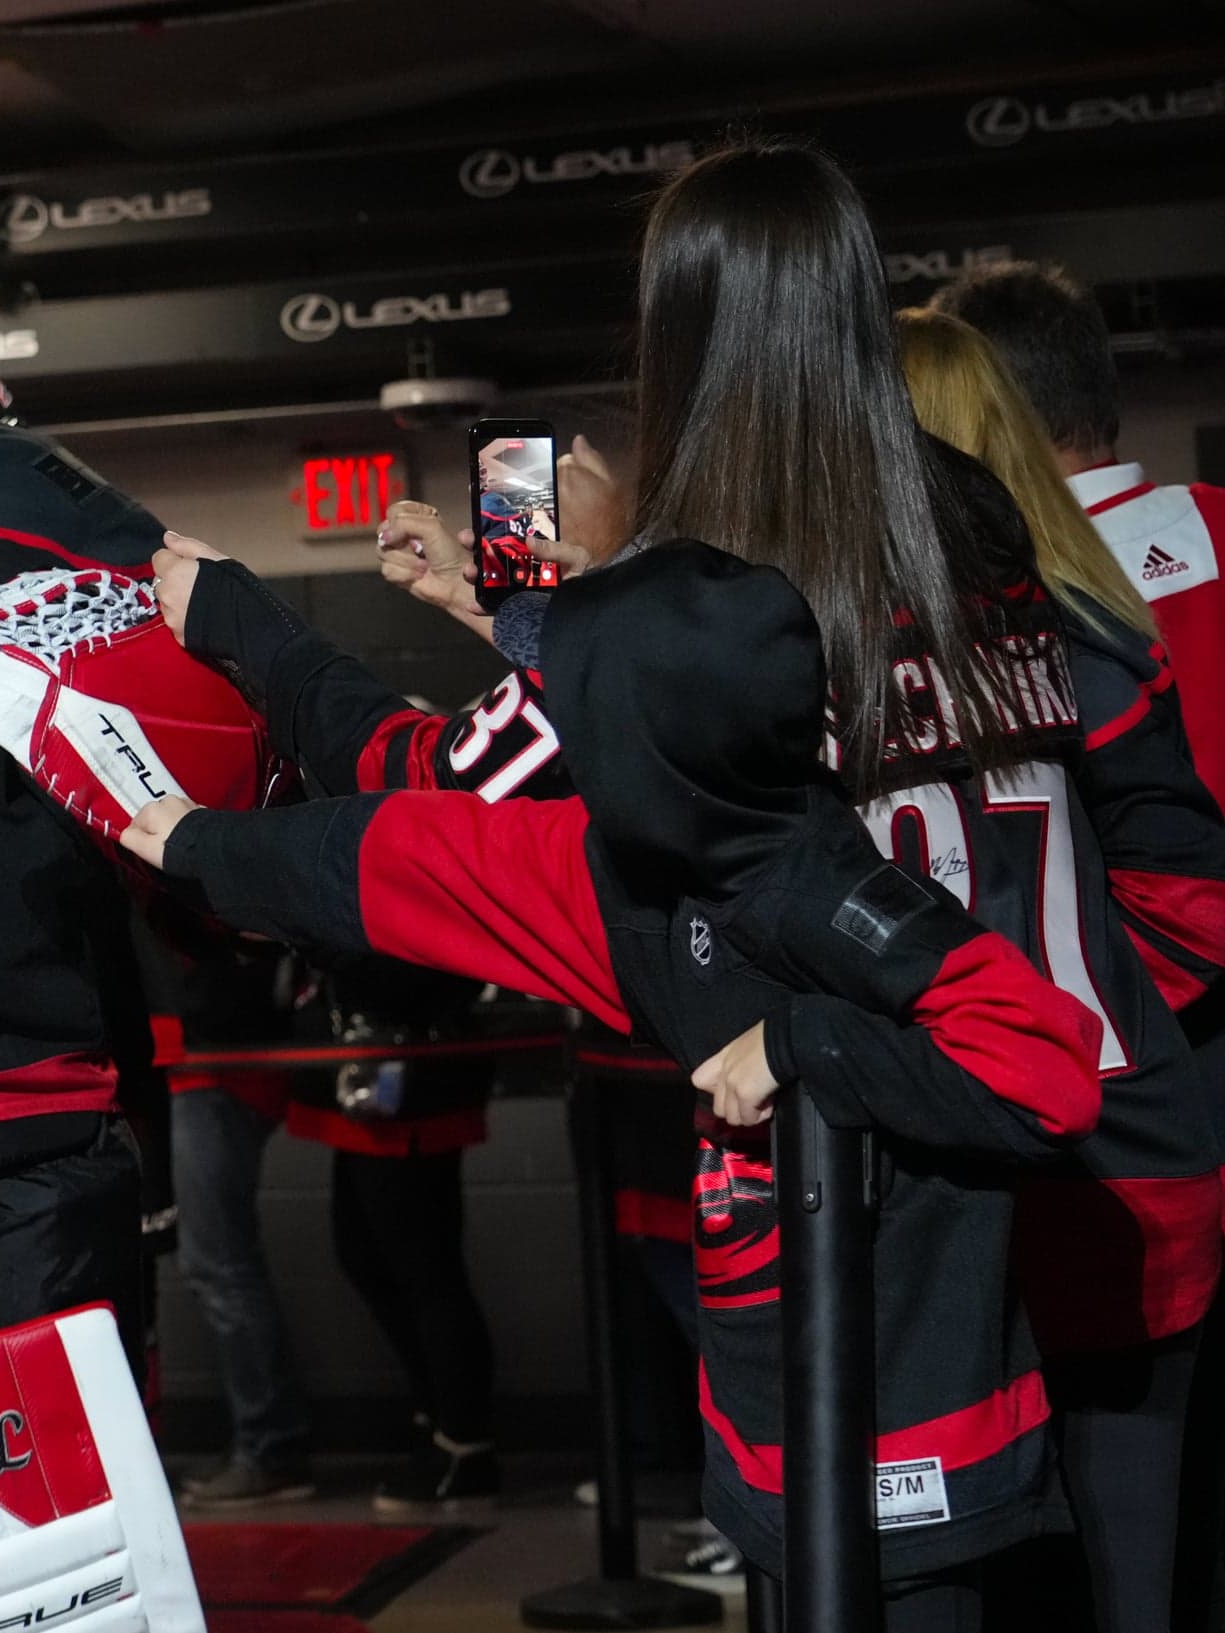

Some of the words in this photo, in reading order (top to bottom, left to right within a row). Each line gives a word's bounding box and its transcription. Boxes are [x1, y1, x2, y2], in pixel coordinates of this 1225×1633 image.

[524, 140, 695, 184] LEXUS
[49, 188, 213, 229] LEXUS
[343, 288, 512, 329] LEXUS
[303, 453, 396, 529] EXIT
[1142, 561, 1189, 581] adidas
[97, 713, 167, 802] TRU
[448, 668, 562, 805] 37
[878, 1475, 925, 1497] S/M
